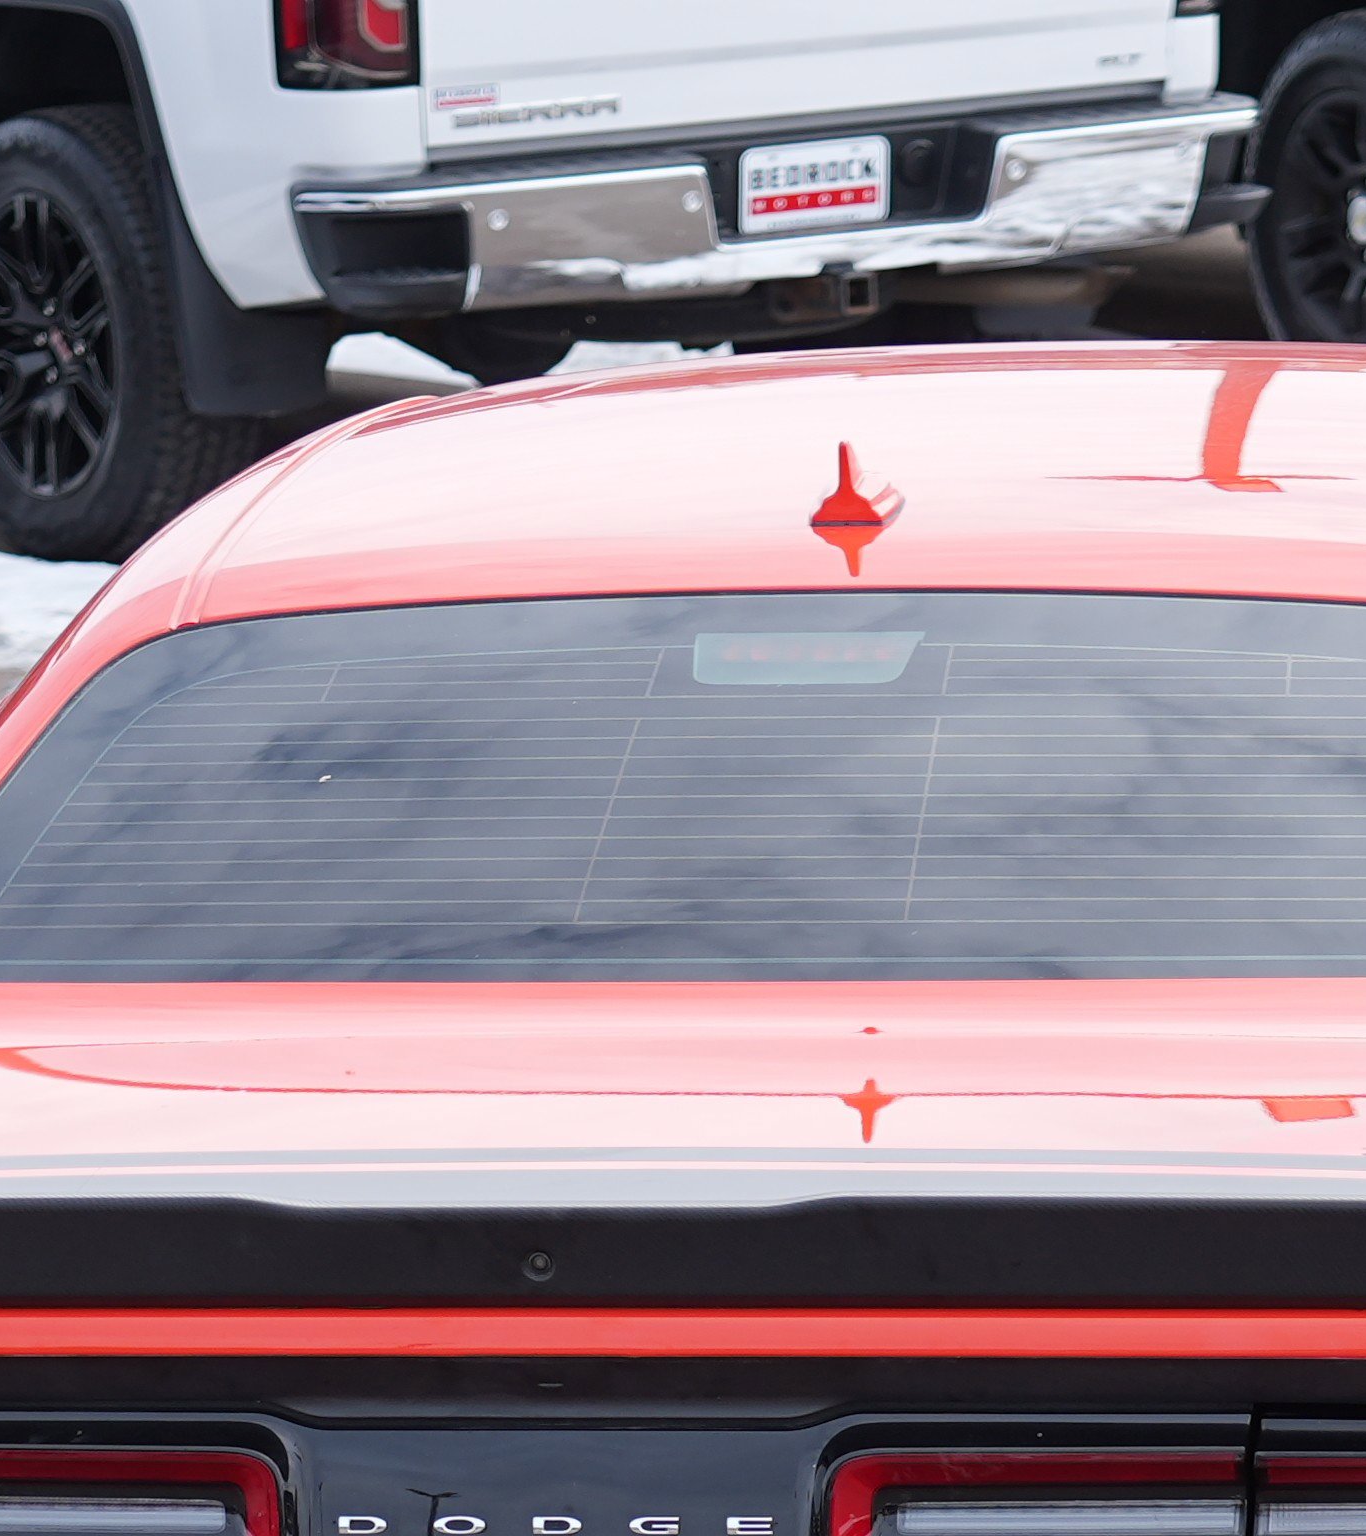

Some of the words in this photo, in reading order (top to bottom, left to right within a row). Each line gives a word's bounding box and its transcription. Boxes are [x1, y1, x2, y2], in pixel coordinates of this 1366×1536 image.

[453, 93, 621, 128] SIERRA
[750, 158, 877, 190] BEDROCK
[753, 188, 875, 212] MOTORS
[338, 1515, 775, 1536] DODGE
